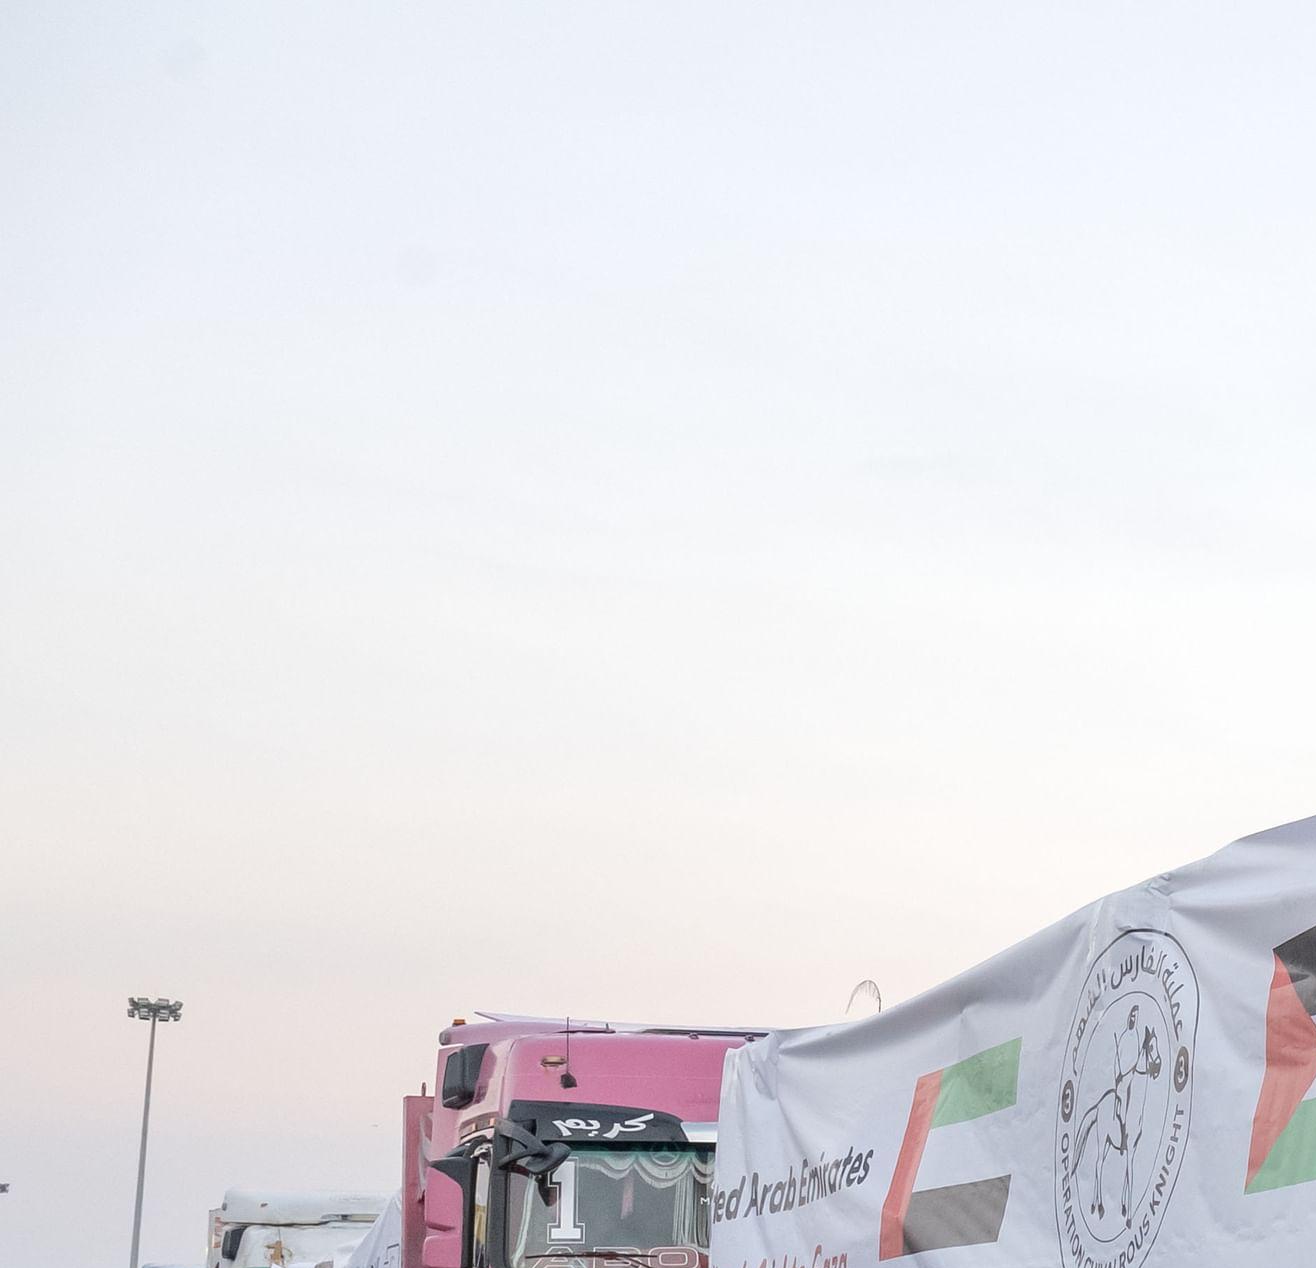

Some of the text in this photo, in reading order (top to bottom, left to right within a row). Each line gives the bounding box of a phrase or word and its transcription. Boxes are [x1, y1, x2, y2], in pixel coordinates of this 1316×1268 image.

[552, 1113, 654, 1139] كريم
[547, 1157, 585, 1244] 1
[743, 1166, 797, 1218] Arab
[798, 1146, 874, 1208] Emirates
[1060, 1132, 1085, 1268] OPERATION
[1149, 1103, 1184, 1216] KNIGHT
